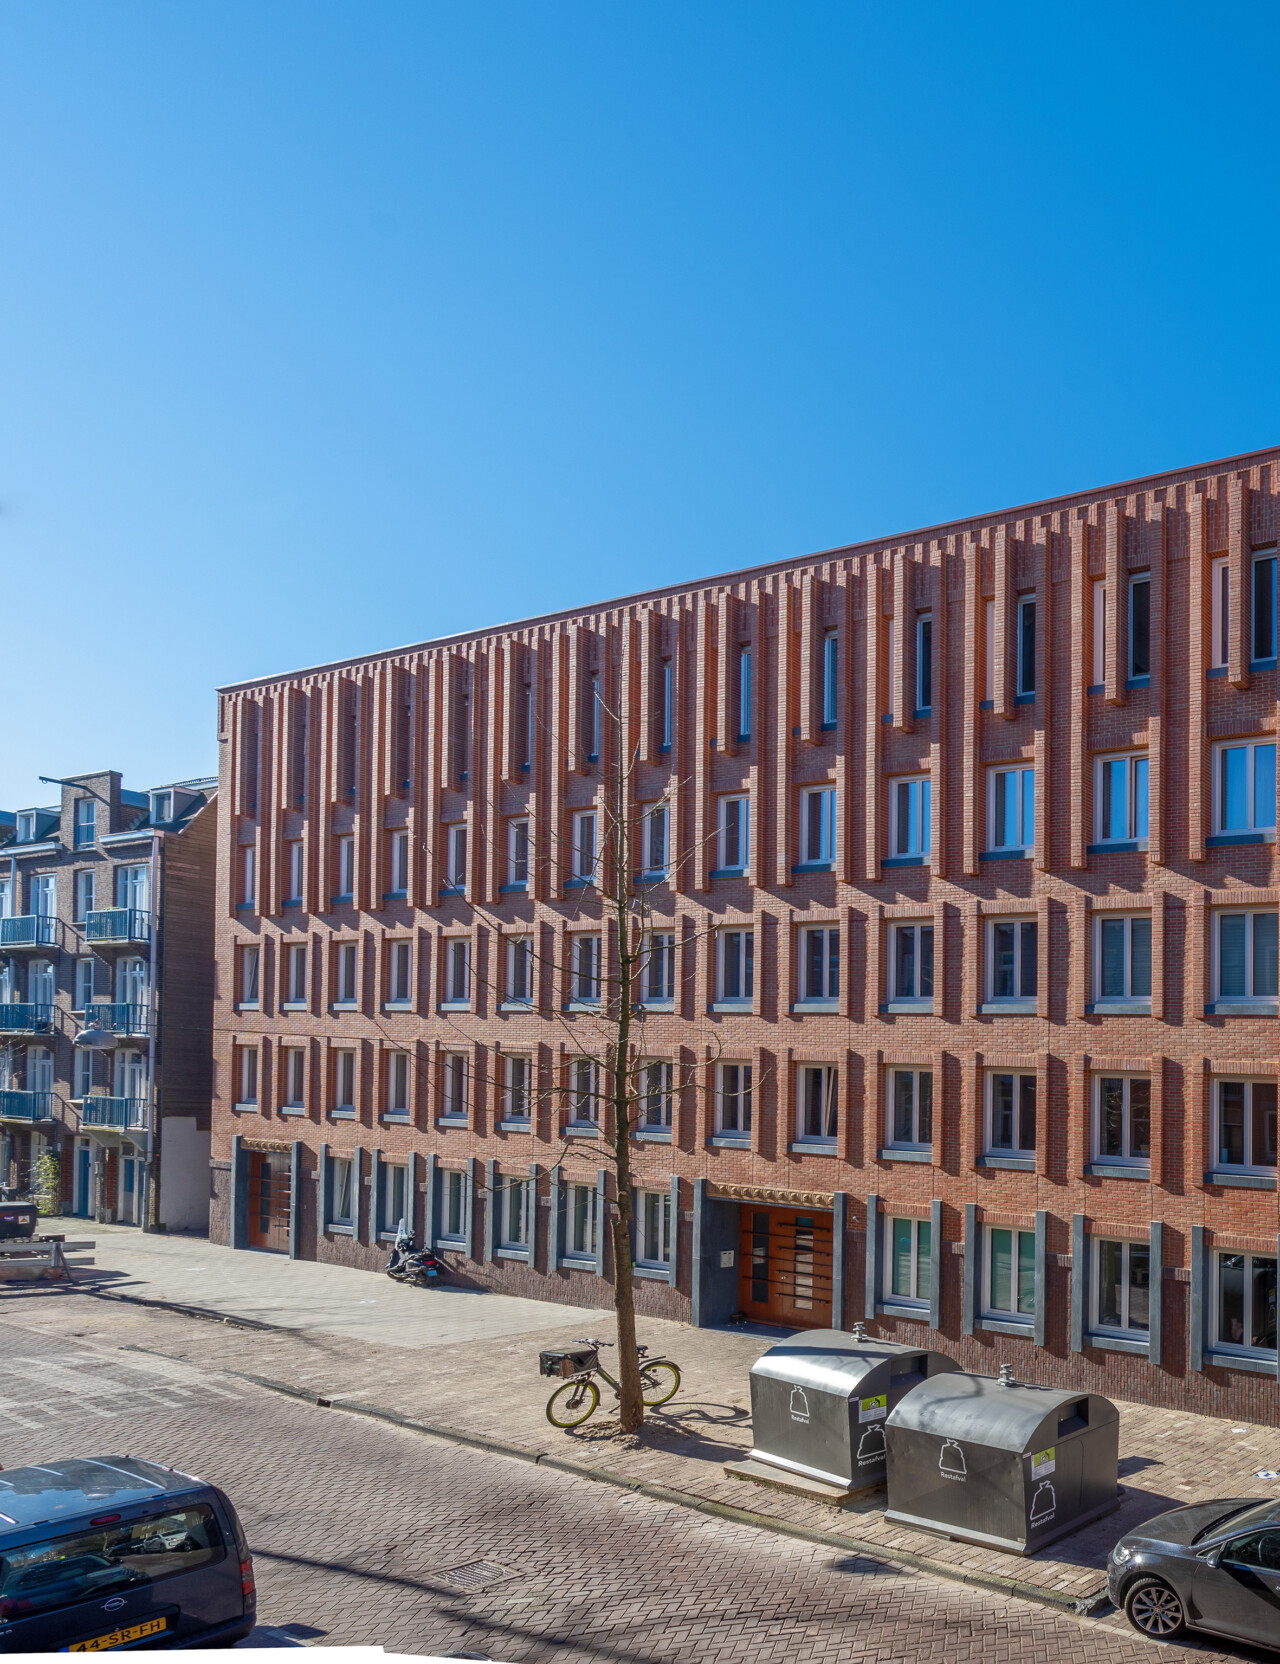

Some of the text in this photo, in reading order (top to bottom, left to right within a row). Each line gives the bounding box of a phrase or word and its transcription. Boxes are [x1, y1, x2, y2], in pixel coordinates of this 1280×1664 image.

[791, 1414, 810, 1424] Restafval
[858, 1454, 886, 1467] Restafval
[940, 1471, 966, 1482] Restafval
[1031, 1512, 1055, 1529] Restafval
[76, 1620, 161, 1652] 44-SR-FH
